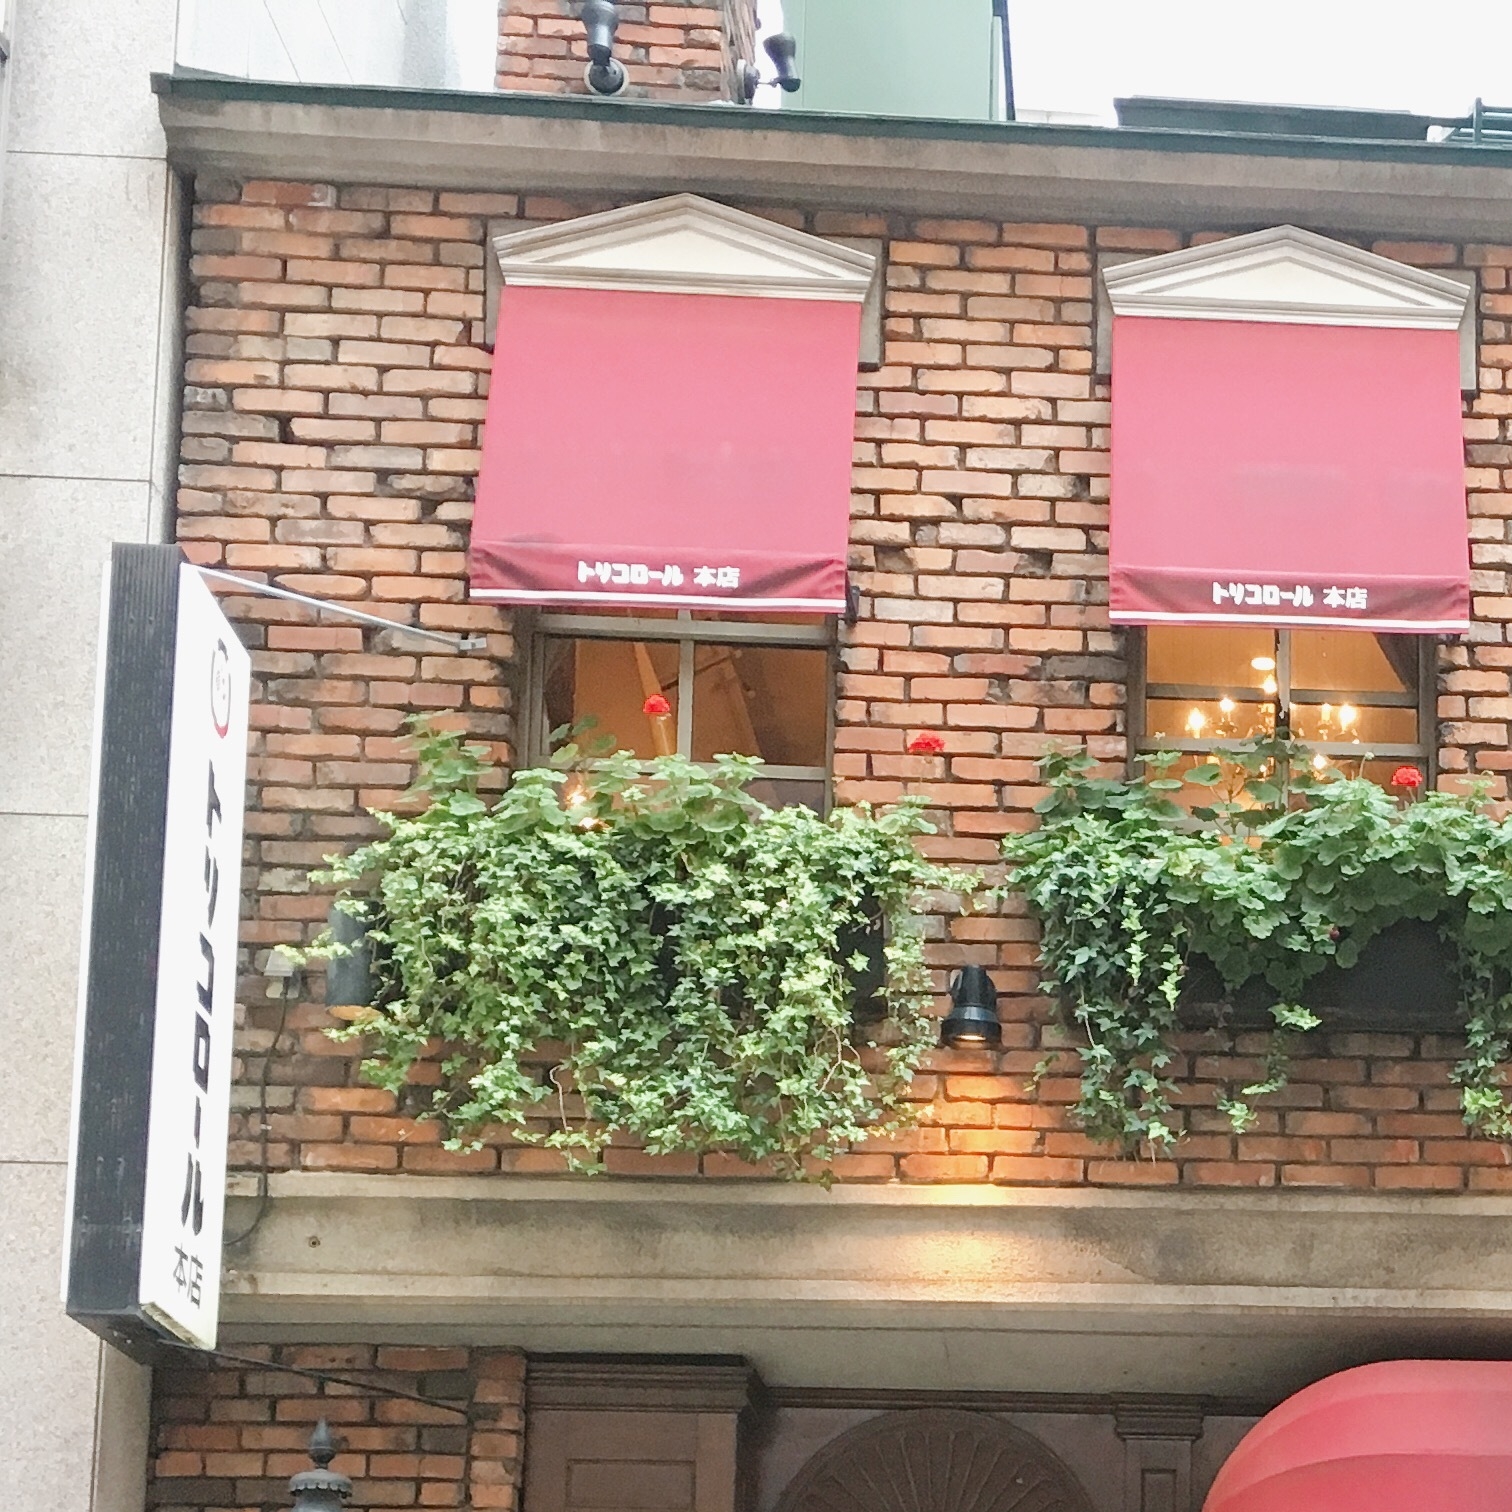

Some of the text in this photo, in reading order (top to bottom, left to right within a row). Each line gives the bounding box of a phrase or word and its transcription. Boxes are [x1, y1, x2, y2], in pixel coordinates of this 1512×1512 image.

[577, 560, 741, 589] トリコロール 本店
[1212, 581, 1368, 610] トリコロール 本店
[182, 758, 223, 1237] トリコロール
[174, 1243, 204, 1310] 本店
